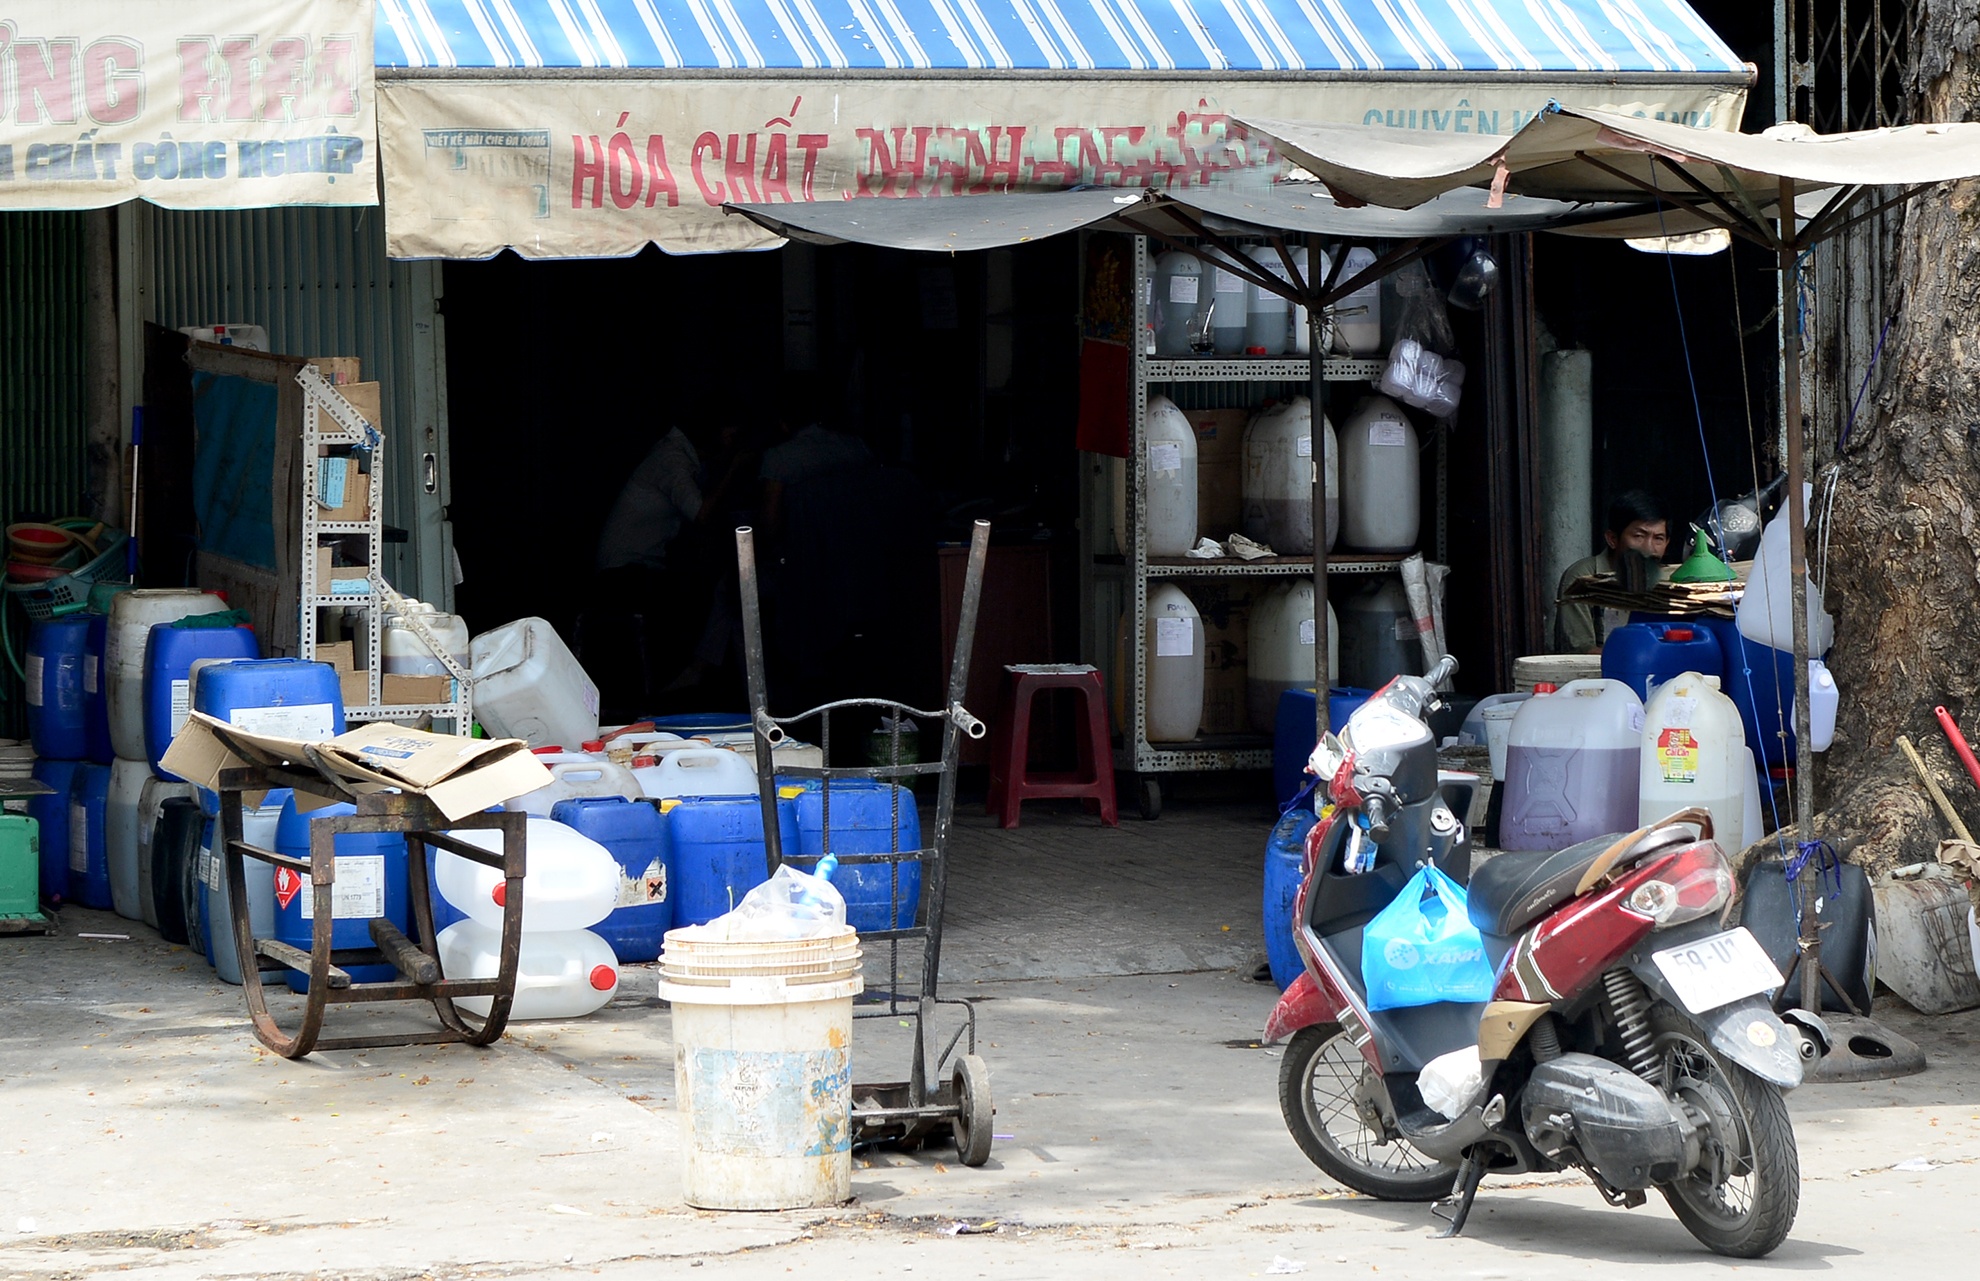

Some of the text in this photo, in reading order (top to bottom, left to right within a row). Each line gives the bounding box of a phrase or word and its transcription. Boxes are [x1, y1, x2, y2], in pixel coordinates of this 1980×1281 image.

[25, 128, 123, 180] CHẤT
[132, 132, 227, 180] CÔNG
[238, 125, 364, 184] NGHIỆP
[485, 135, 504, 146] CHE
[572, 112, 679, 210] HÓA
[691, 96, 829, 206] CHẤT
